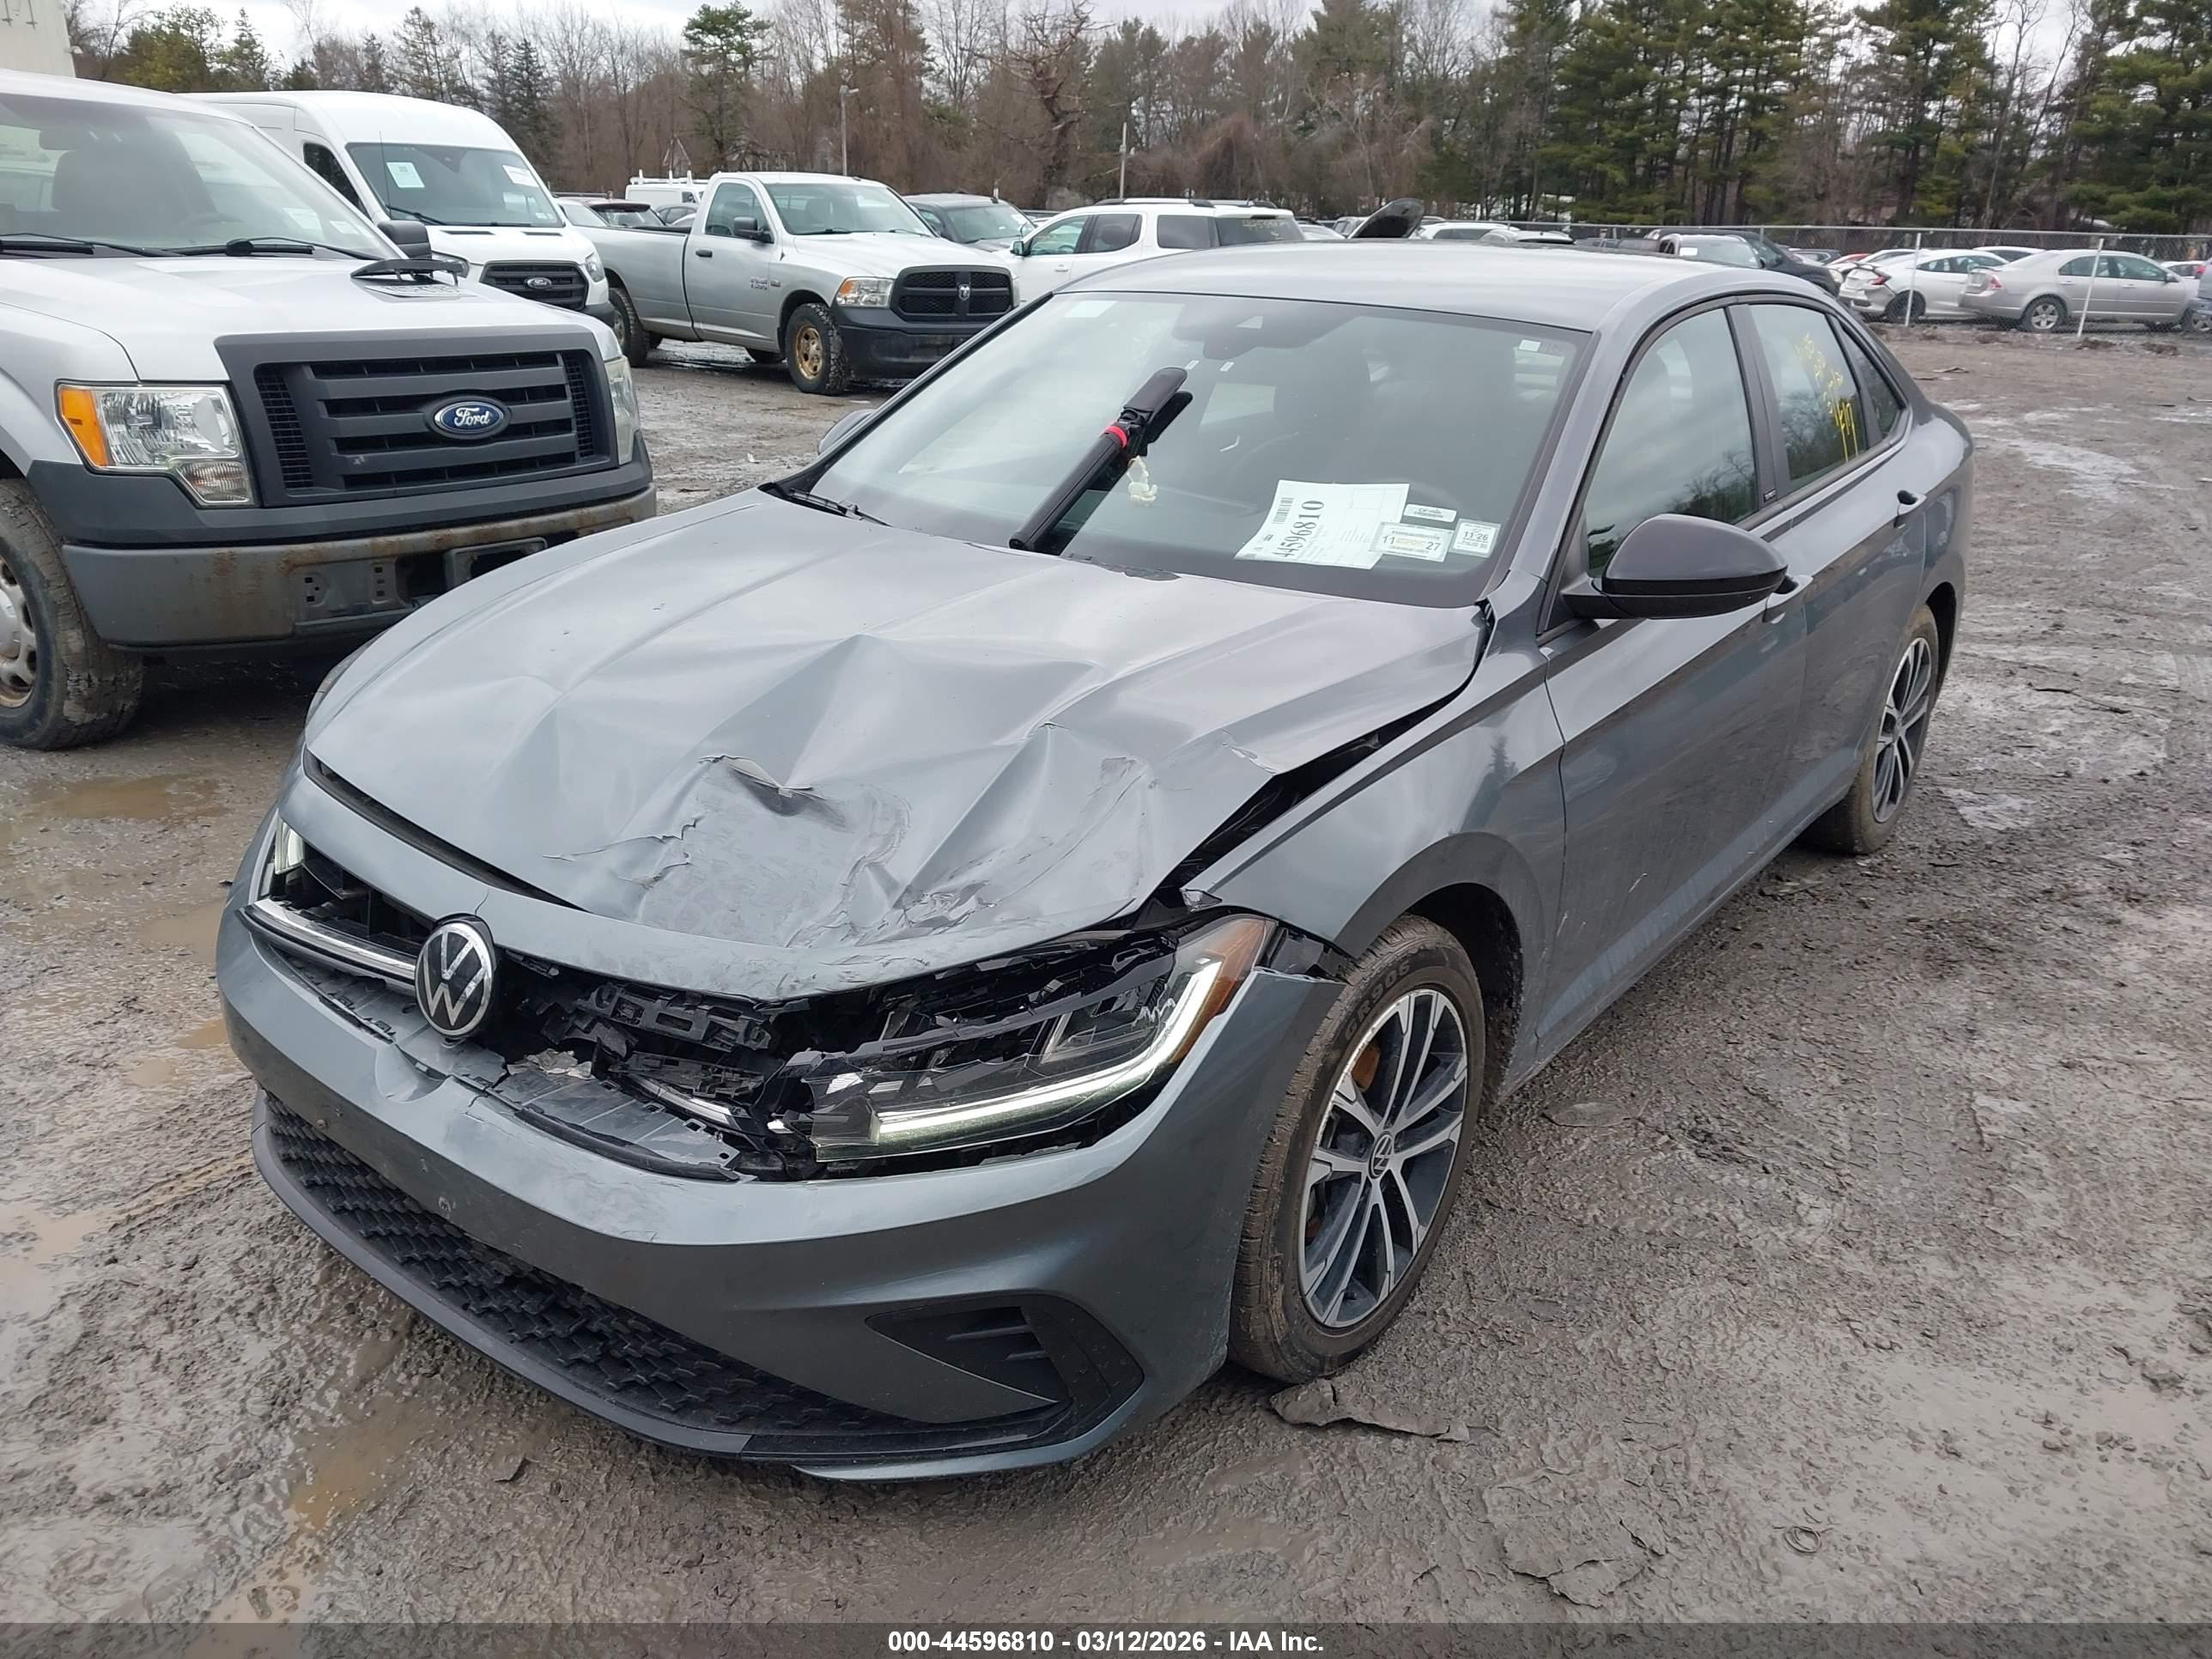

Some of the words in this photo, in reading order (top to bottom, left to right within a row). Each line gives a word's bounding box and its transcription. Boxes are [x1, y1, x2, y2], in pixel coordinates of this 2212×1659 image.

[453, 407, 490, 427] Ford
[1272, 500, 1325, 558] 44596810
[1382, 535, 1395, 545] 11
[1425, 541, 1442, 551] 27
[1476, 532, 1489, 541] 26
[419, 927, 489, 1030] VW
[1345, 962, 1411, 1041] GR906
